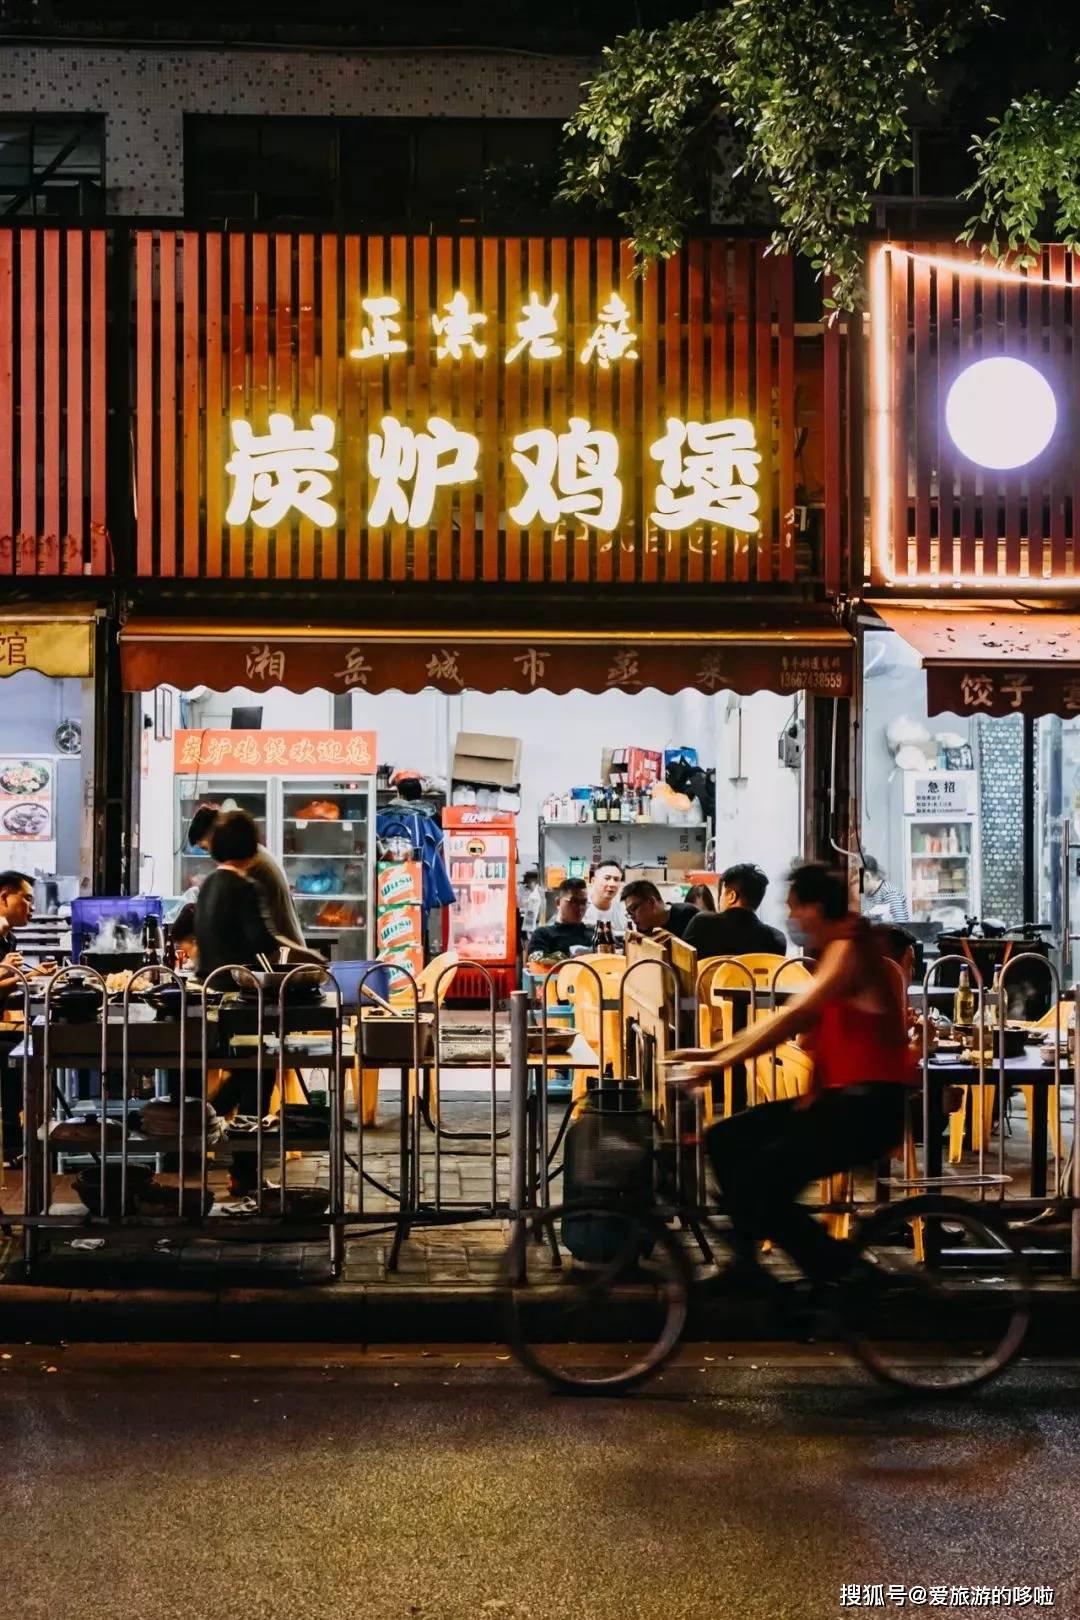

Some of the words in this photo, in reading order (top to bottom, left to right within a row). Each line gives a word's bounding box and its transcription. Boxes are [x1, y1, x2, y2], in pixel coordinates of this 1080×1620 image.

[226, 414, 762, 532] 炭炉鸡煲
[961, 673, 1033, 707] 饺子
[928, 781, 955, 793] 急招
